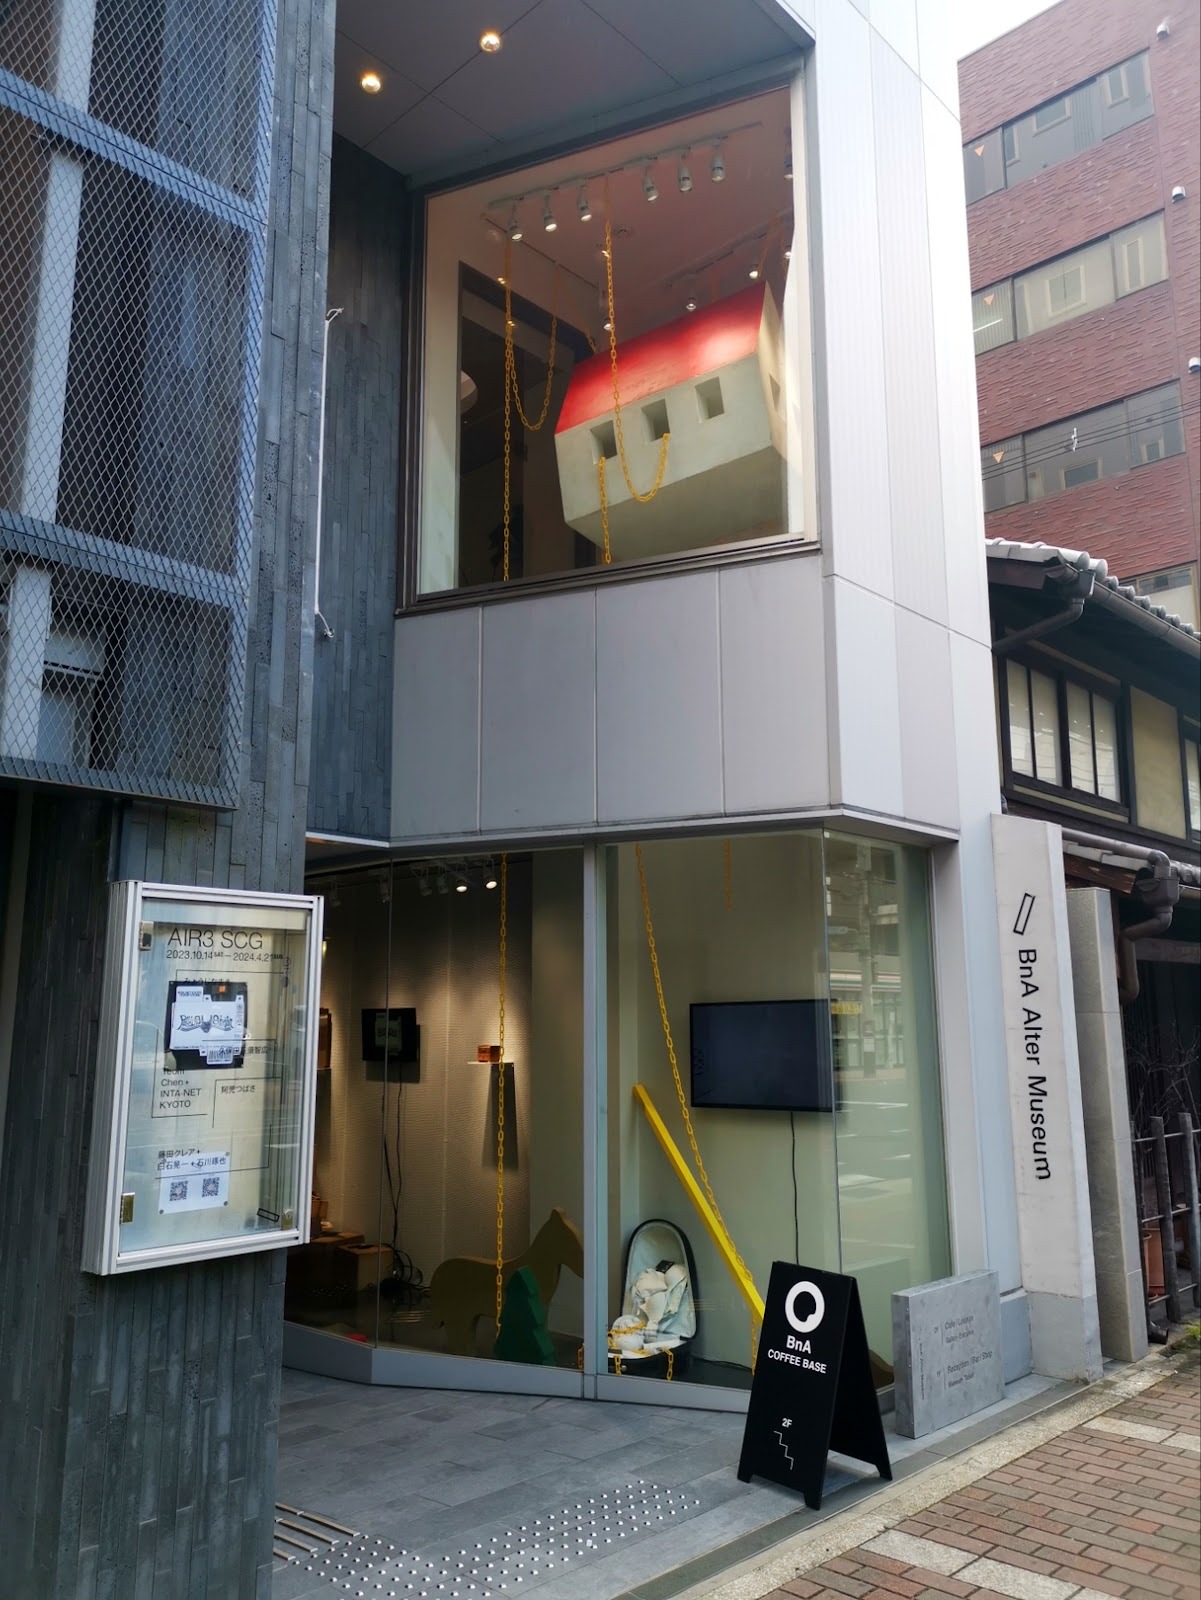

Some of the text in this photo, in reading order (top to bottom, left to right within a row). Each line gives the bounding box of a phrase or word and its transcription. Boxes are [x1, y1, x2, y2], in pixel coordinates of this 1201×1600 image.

[168, 928, 263, 950] AIR3 SCG
[1018, 949, 1052, 1180] BnA Alter Museum
[161, 1079, 183, 1087] Chen
[160, 1088, 202, 1097] INTA-NET
[159, 1100, 191, 1109] KYOTO
[786, 1334, 812, 1354] BnA
[767, 1348, 827, 1374] COFFEE BASE
[781, 1417, 793, 1428] 2F
